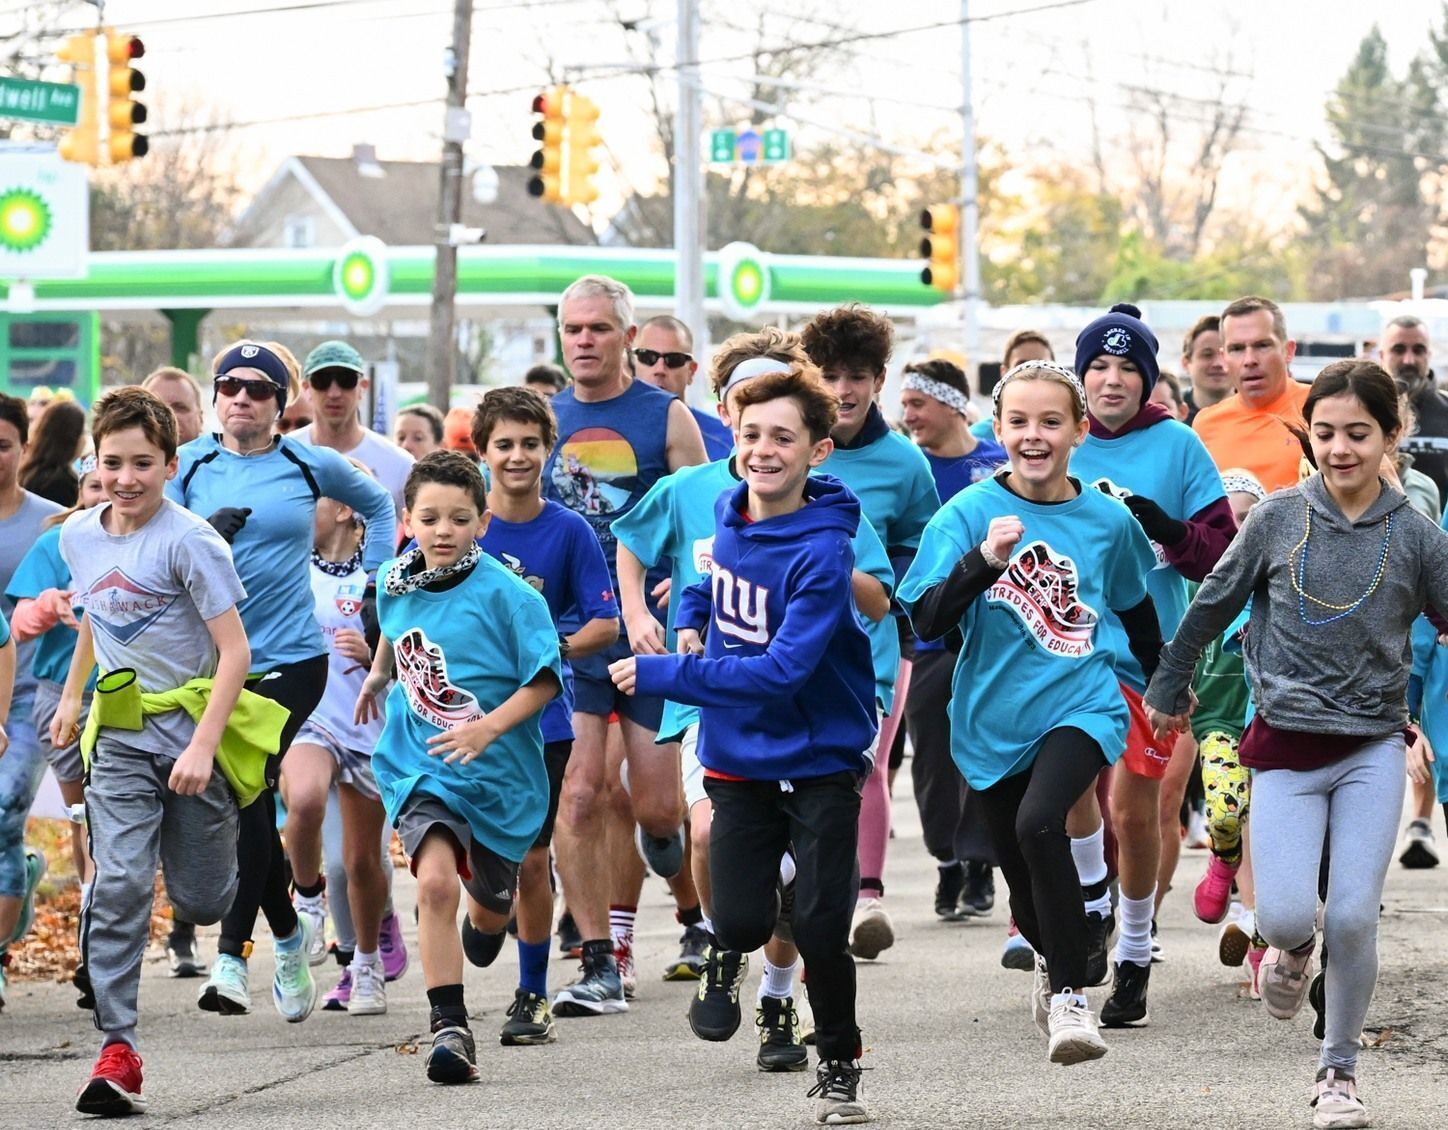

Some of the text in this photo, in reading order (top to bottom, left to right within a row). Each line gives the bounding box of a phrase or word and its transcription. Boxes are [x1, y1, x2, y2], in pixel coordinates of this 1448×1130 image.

[50, 87, 74, 107] Ave
[987, 586, 1091, 655] STRIDES FOR EDUCA
[413, 699, 428, 718] FOR
